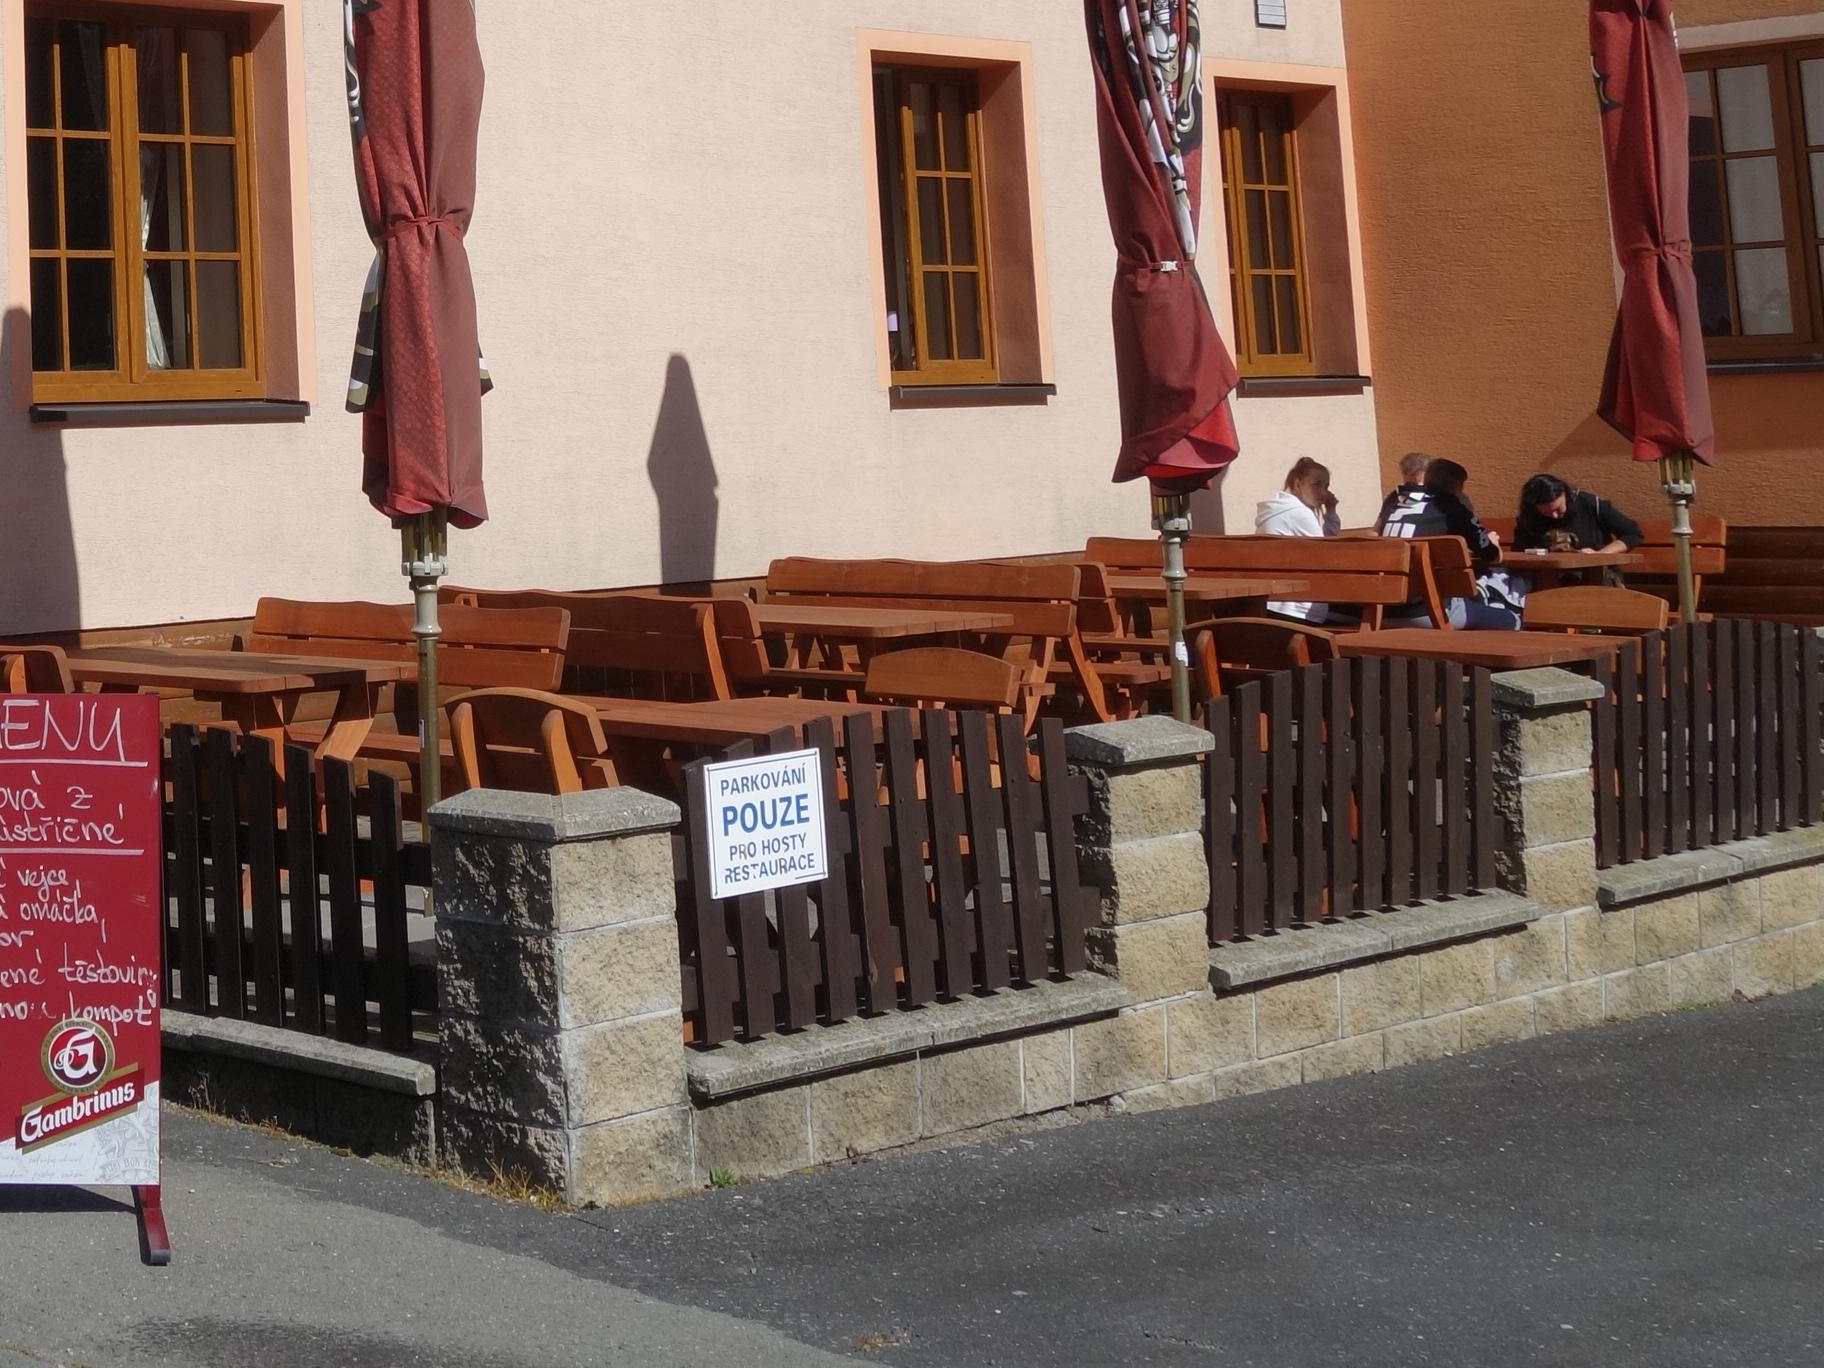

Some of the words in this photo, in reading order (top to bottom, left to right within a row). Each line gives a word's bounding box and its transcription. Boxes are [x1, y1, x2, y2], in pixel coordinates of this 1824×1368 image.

[720, 762, 807, 797] PARKOVÁNÍ
[722, 793, 810, 837] POUZE
[729, 841, 757, 862] PRO
[761, 832, 807, 855] HOSTY
[20, 1082, 136, 1144] Gambrinus
